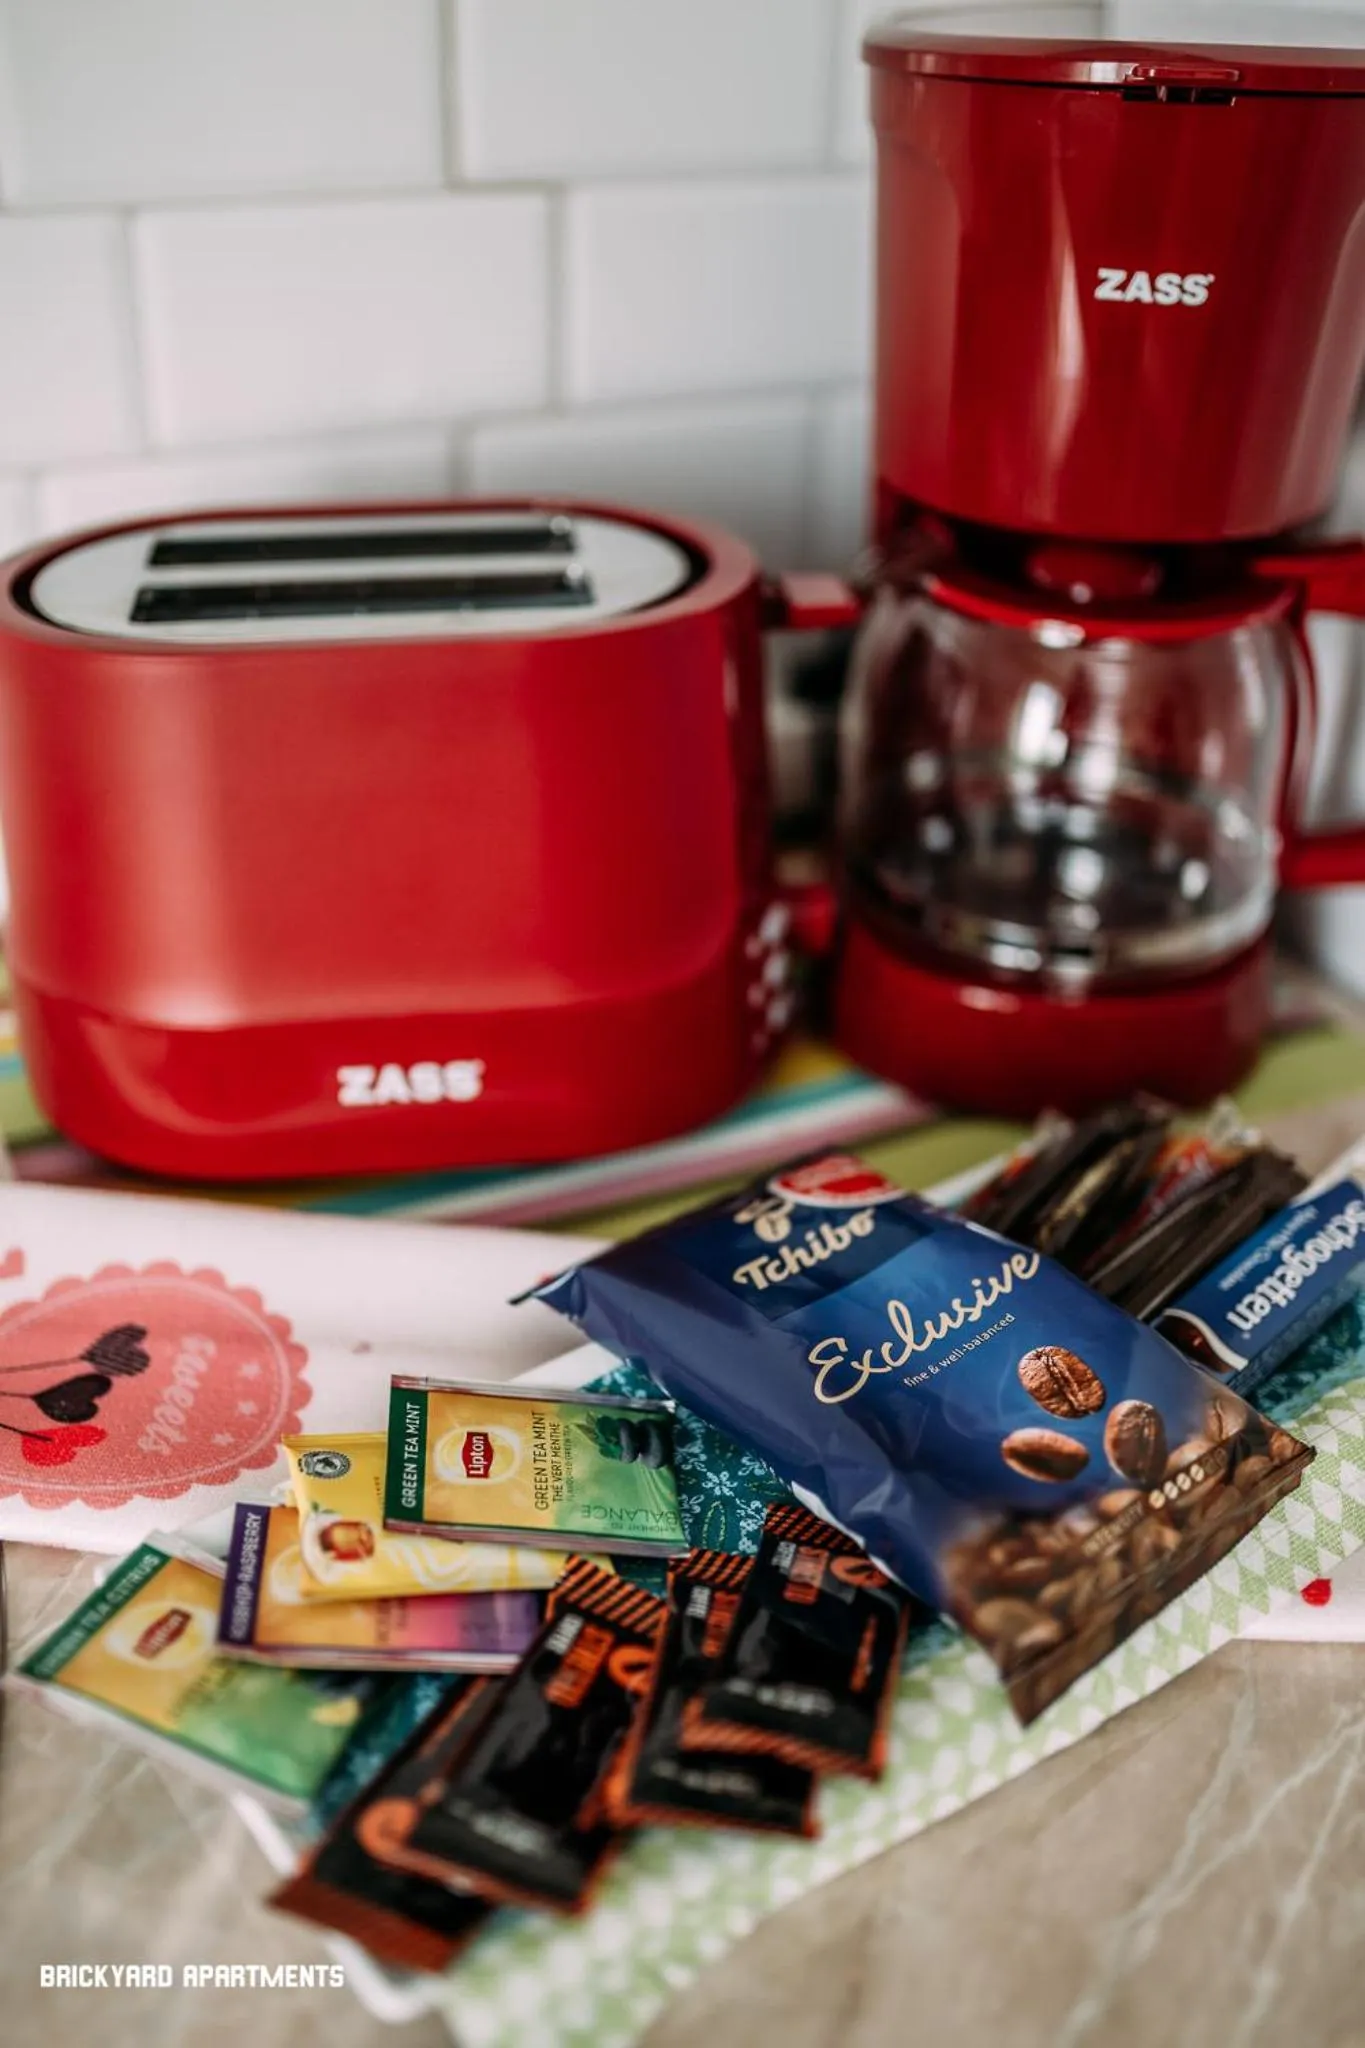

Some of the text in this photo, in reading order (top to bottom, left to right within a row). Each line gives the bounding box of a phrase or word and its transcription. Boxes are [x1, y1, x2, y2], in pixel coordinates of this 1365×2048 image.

[1094, 267, 1212, 306] ZASS
[336, 1060, 485, 1107] ZASS
[733, 1208, 876, 1290] Tchibo
[807, 1252, 1041, 1404] Exclusive
[903, 1312, 1017, 1388] fine & well-balanced
[401, 1402, 421, 1509] GREEN TEA MINT
[468, 1435, 489, 1476] Lipton
[531, 1411, 550, 1511] GREEN TEA MINT
[549, 1422, 562, 1459] MENTHE
[551, 1459, 563, 1482] VERT
[580, 1504, 679, 1526] BALANCE
